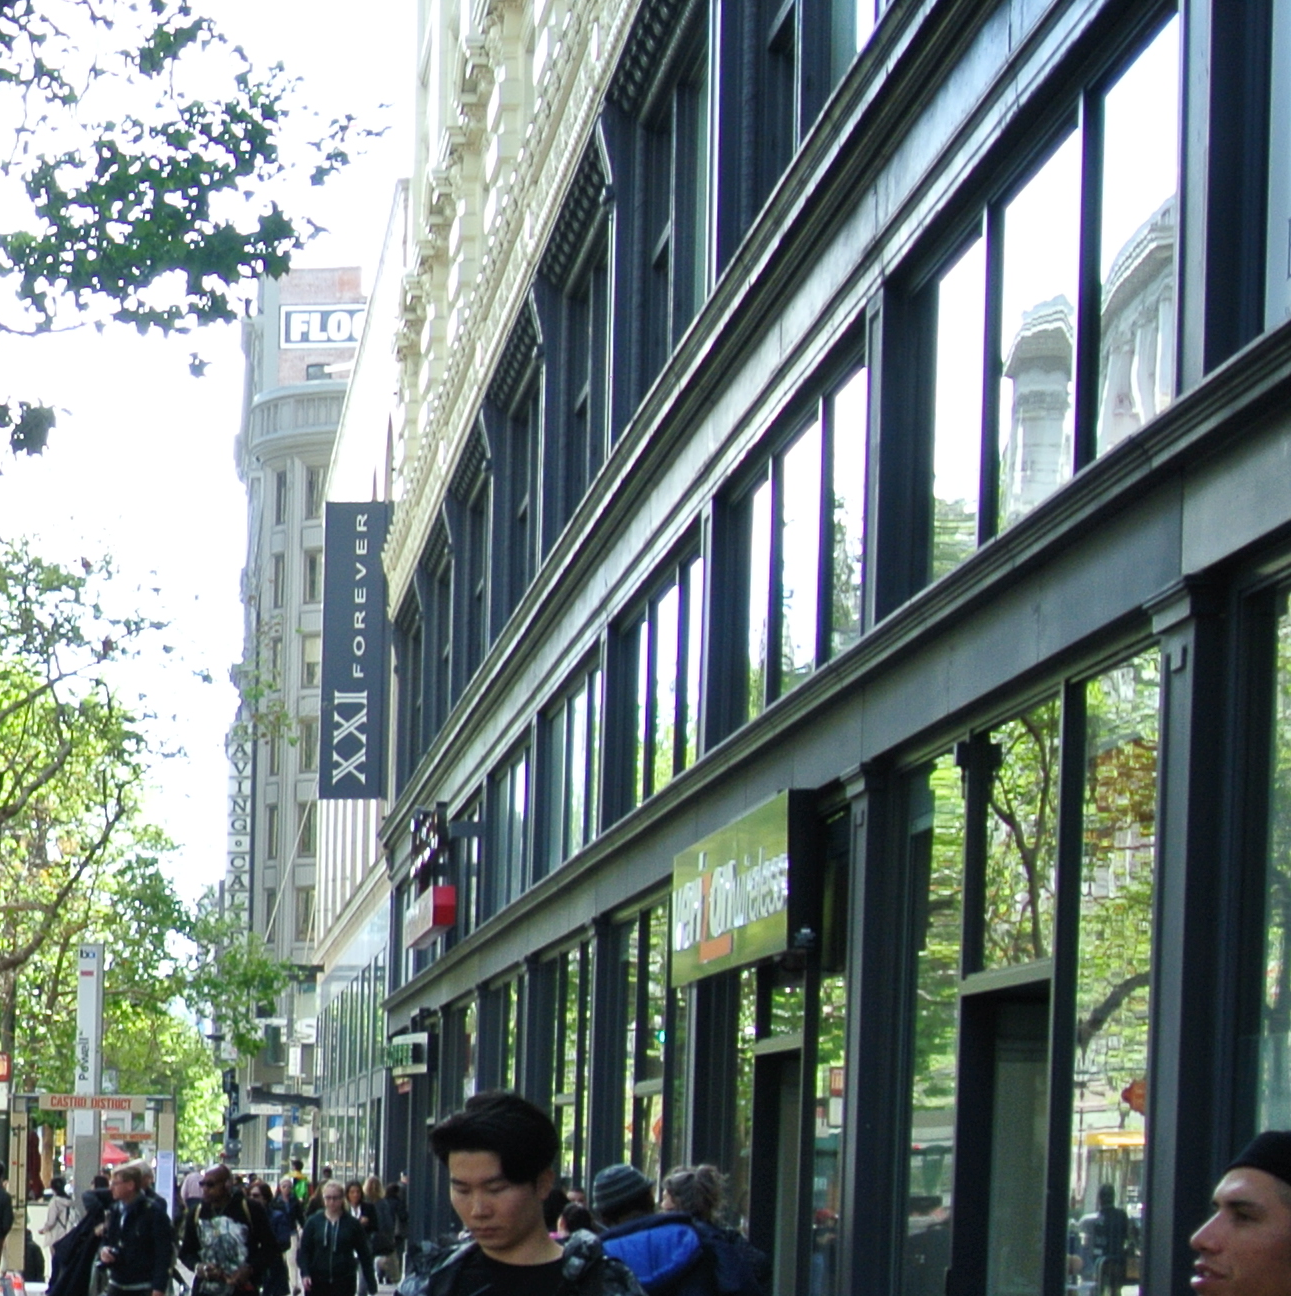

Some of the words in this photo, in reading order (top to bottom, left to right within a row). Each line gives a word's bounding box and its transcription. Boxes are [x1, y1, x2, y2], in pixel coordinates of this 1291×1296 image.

[332, 689, 368, 786] XXI
[352, 512, 369, 678] FOREVER
[229, 724, 249, 832] AVING
[78, 1036, 89, 1082] Powell
[50, 1096, 87, 1107] CASTRO
[90, 1097, 132, 1109] DISTRICT
